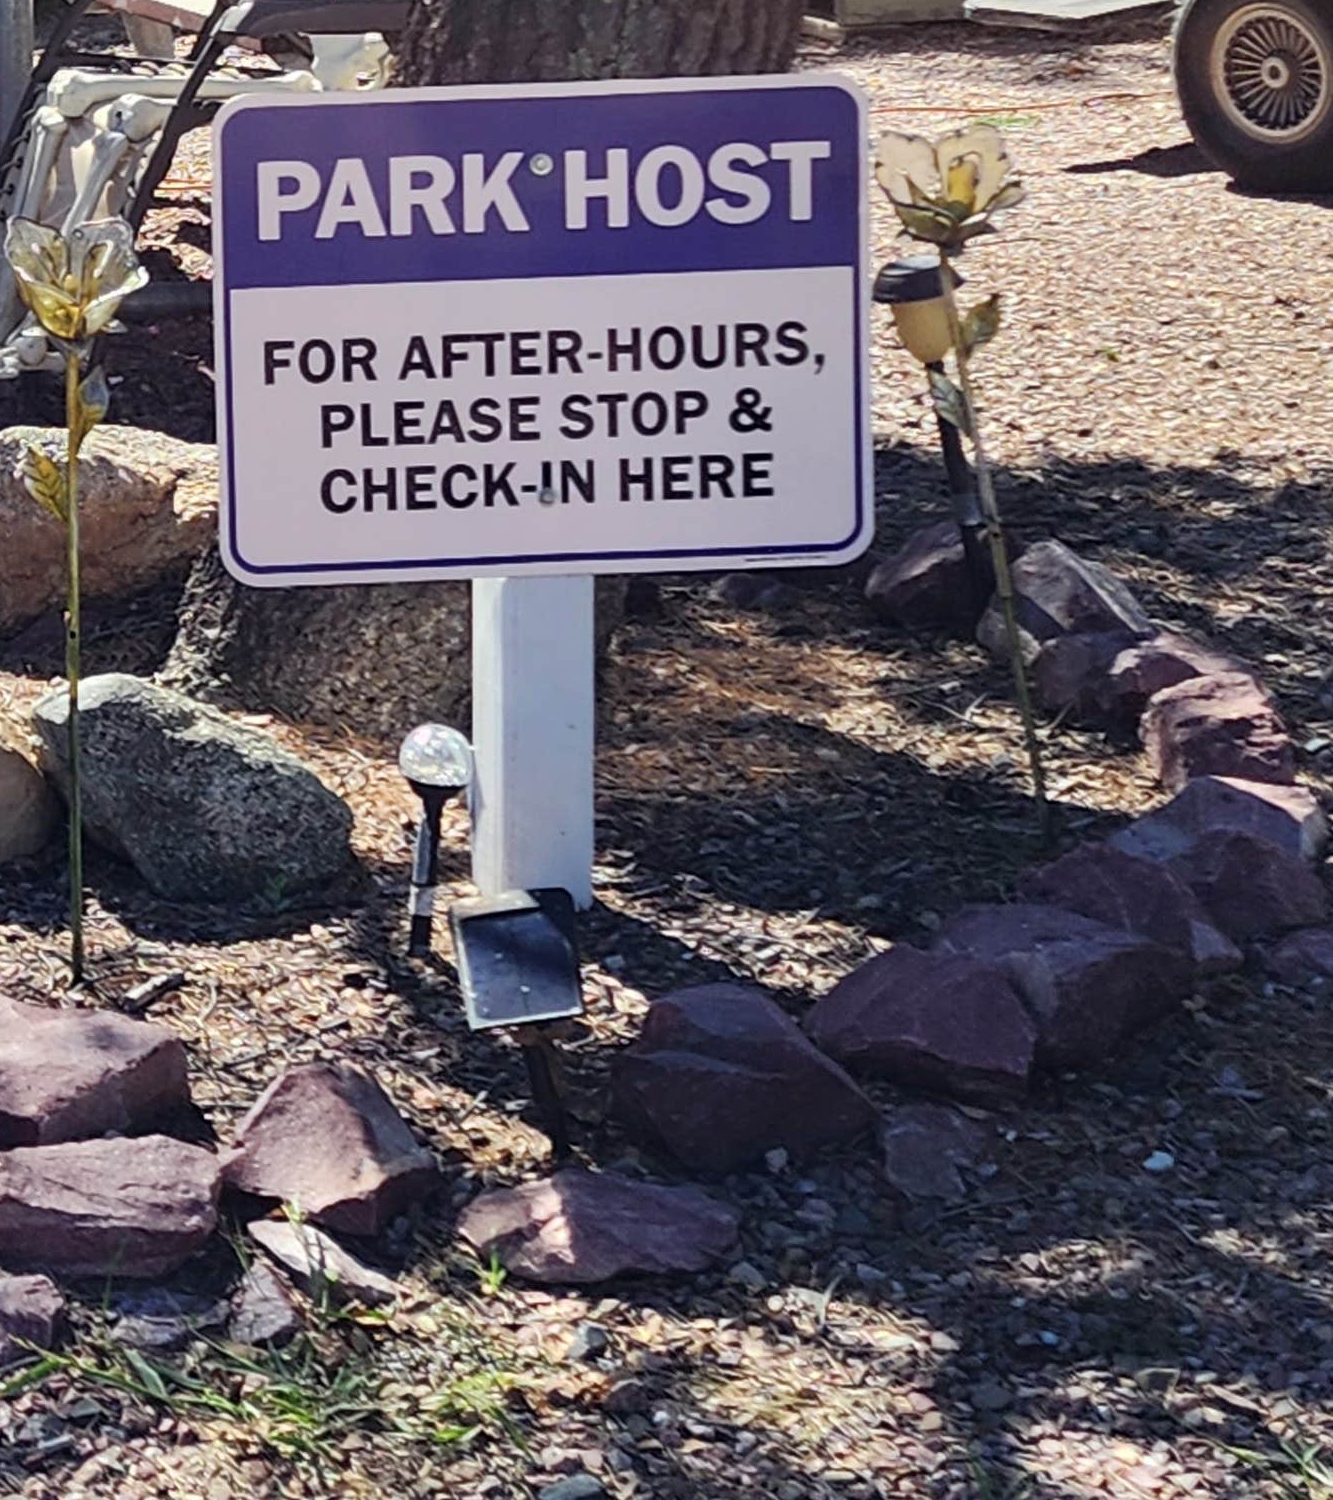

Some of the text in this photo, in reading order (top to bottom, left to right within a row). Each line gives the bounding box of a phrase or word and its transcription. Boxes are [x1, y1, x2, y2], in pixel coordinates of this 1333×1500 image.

[256, 141, 831, 241] PARK HOST
[262, 321, 827, 385] FOR AFTER-HOURS,
[319, 387, 774, 448] PLEASE STOP &
[319, 452, 775, 514] CHECK-IN HERE
